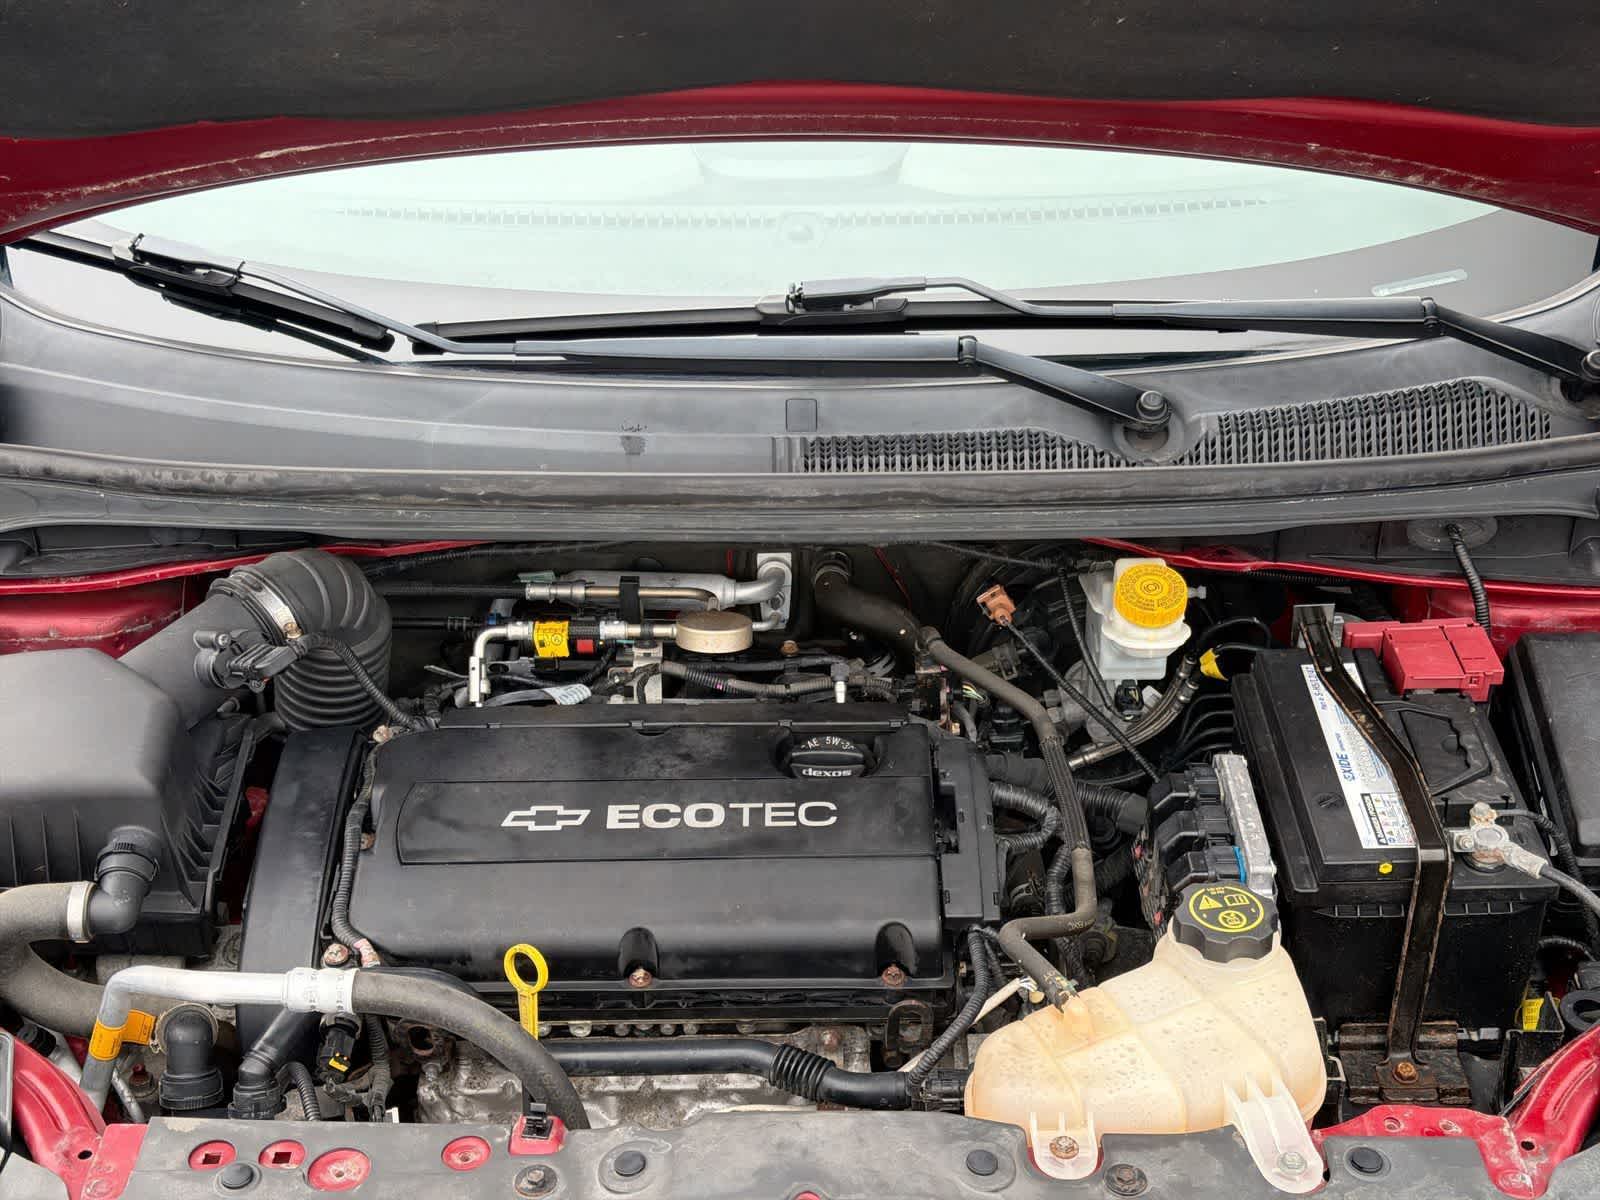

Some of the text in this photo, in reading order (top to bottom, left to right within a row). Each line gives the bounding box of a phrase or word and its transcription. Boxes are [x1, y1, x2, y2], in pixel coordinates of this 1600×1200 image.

[802, 767, 852, 777] dexos
[1335, 751, 1356, 781] EXIDE
[606, 801, 837, 829] ECOTEC
